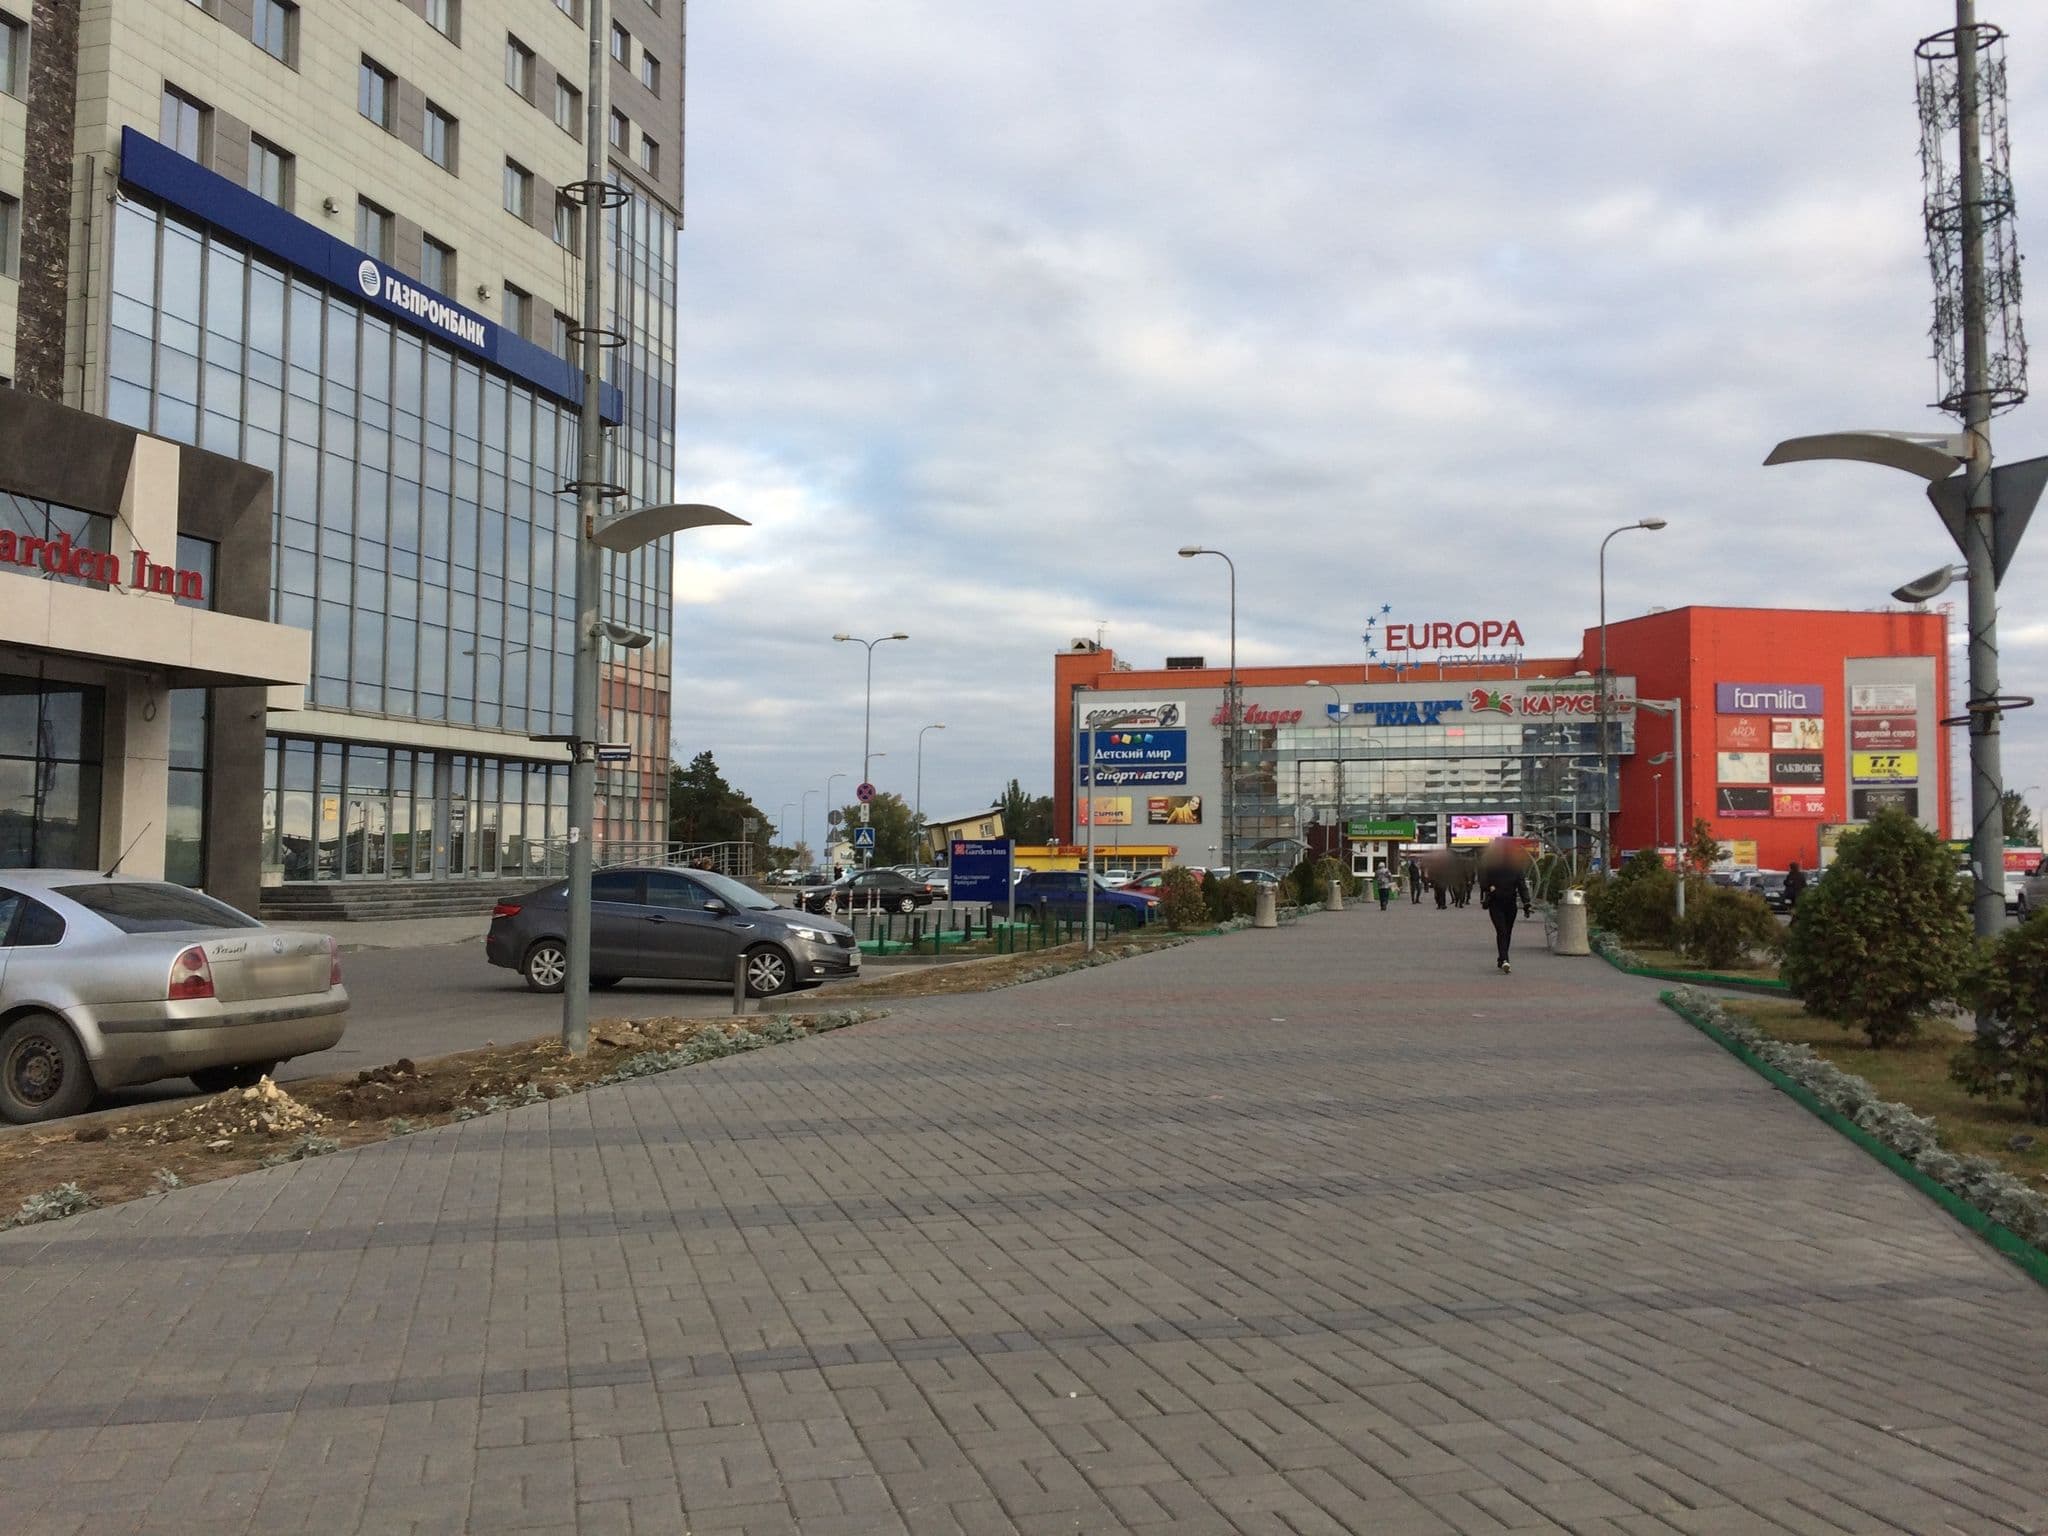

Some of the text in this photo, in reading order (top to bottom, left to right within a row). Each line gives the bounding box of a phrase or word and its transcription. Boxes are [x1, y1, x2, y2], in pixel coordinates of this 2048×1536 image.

[385, 275, 486, 348] ГАЗПРОМБАНК
[0, 527, 205, 600] arden Inn
[1386, 619, 1524, 652] EUROPA
[1522, 694, 1633, 715] КАРУСЕЬ
[1734, 687, 1807, 710] familia
[1376, 711, 1441, 726] IMAX
[1094, 748, 1172, 761] Детский мир
